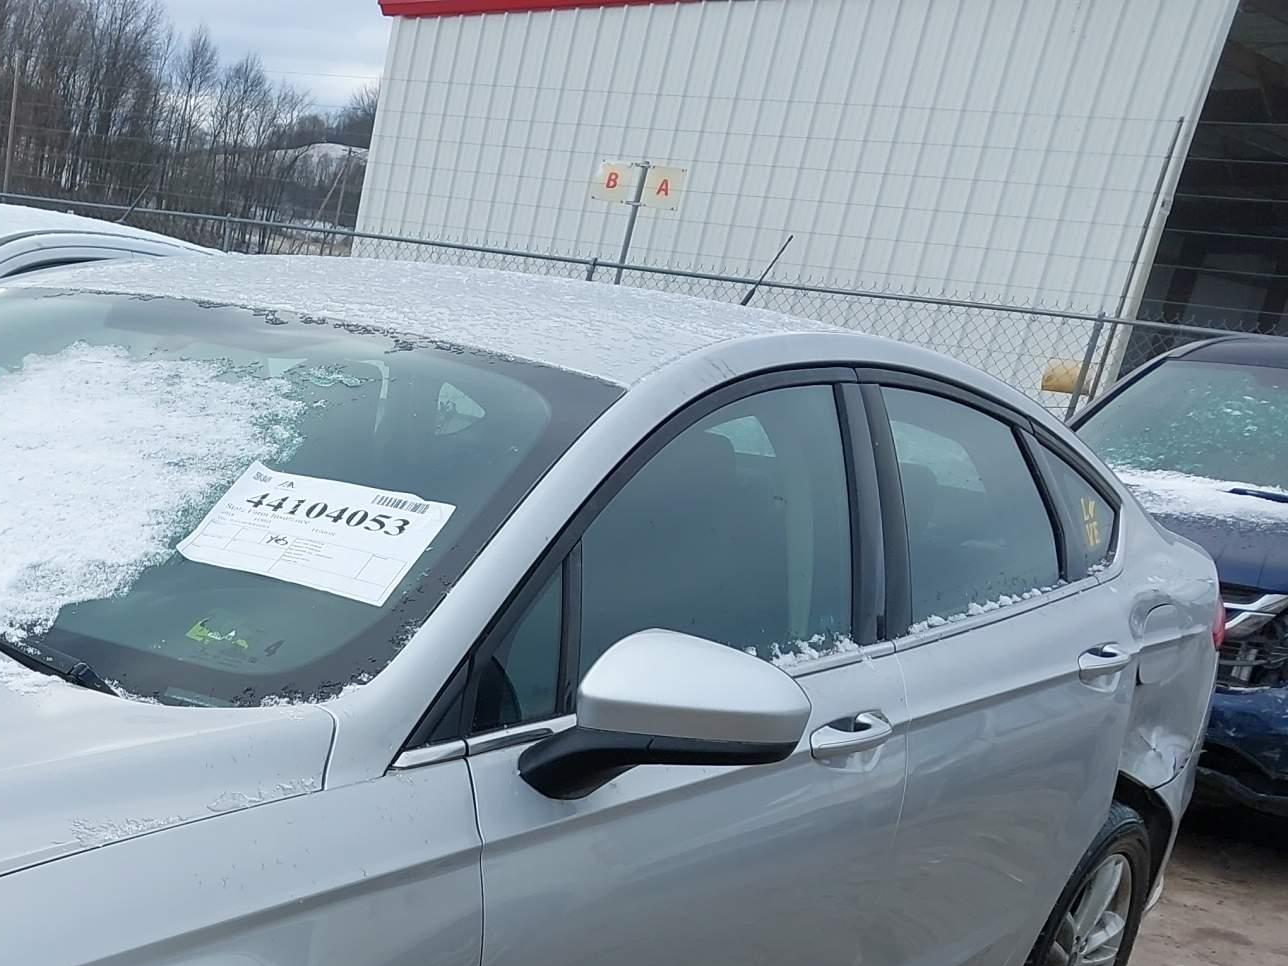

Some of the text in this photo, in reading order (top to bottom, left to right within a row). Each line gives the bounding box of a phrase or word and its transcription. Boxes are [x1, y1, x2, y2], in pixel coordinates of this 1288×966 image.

[606, 172, 619, 188] B
[656, 179, 669, 196] A
[246, 493, 410, 536] 44104053
